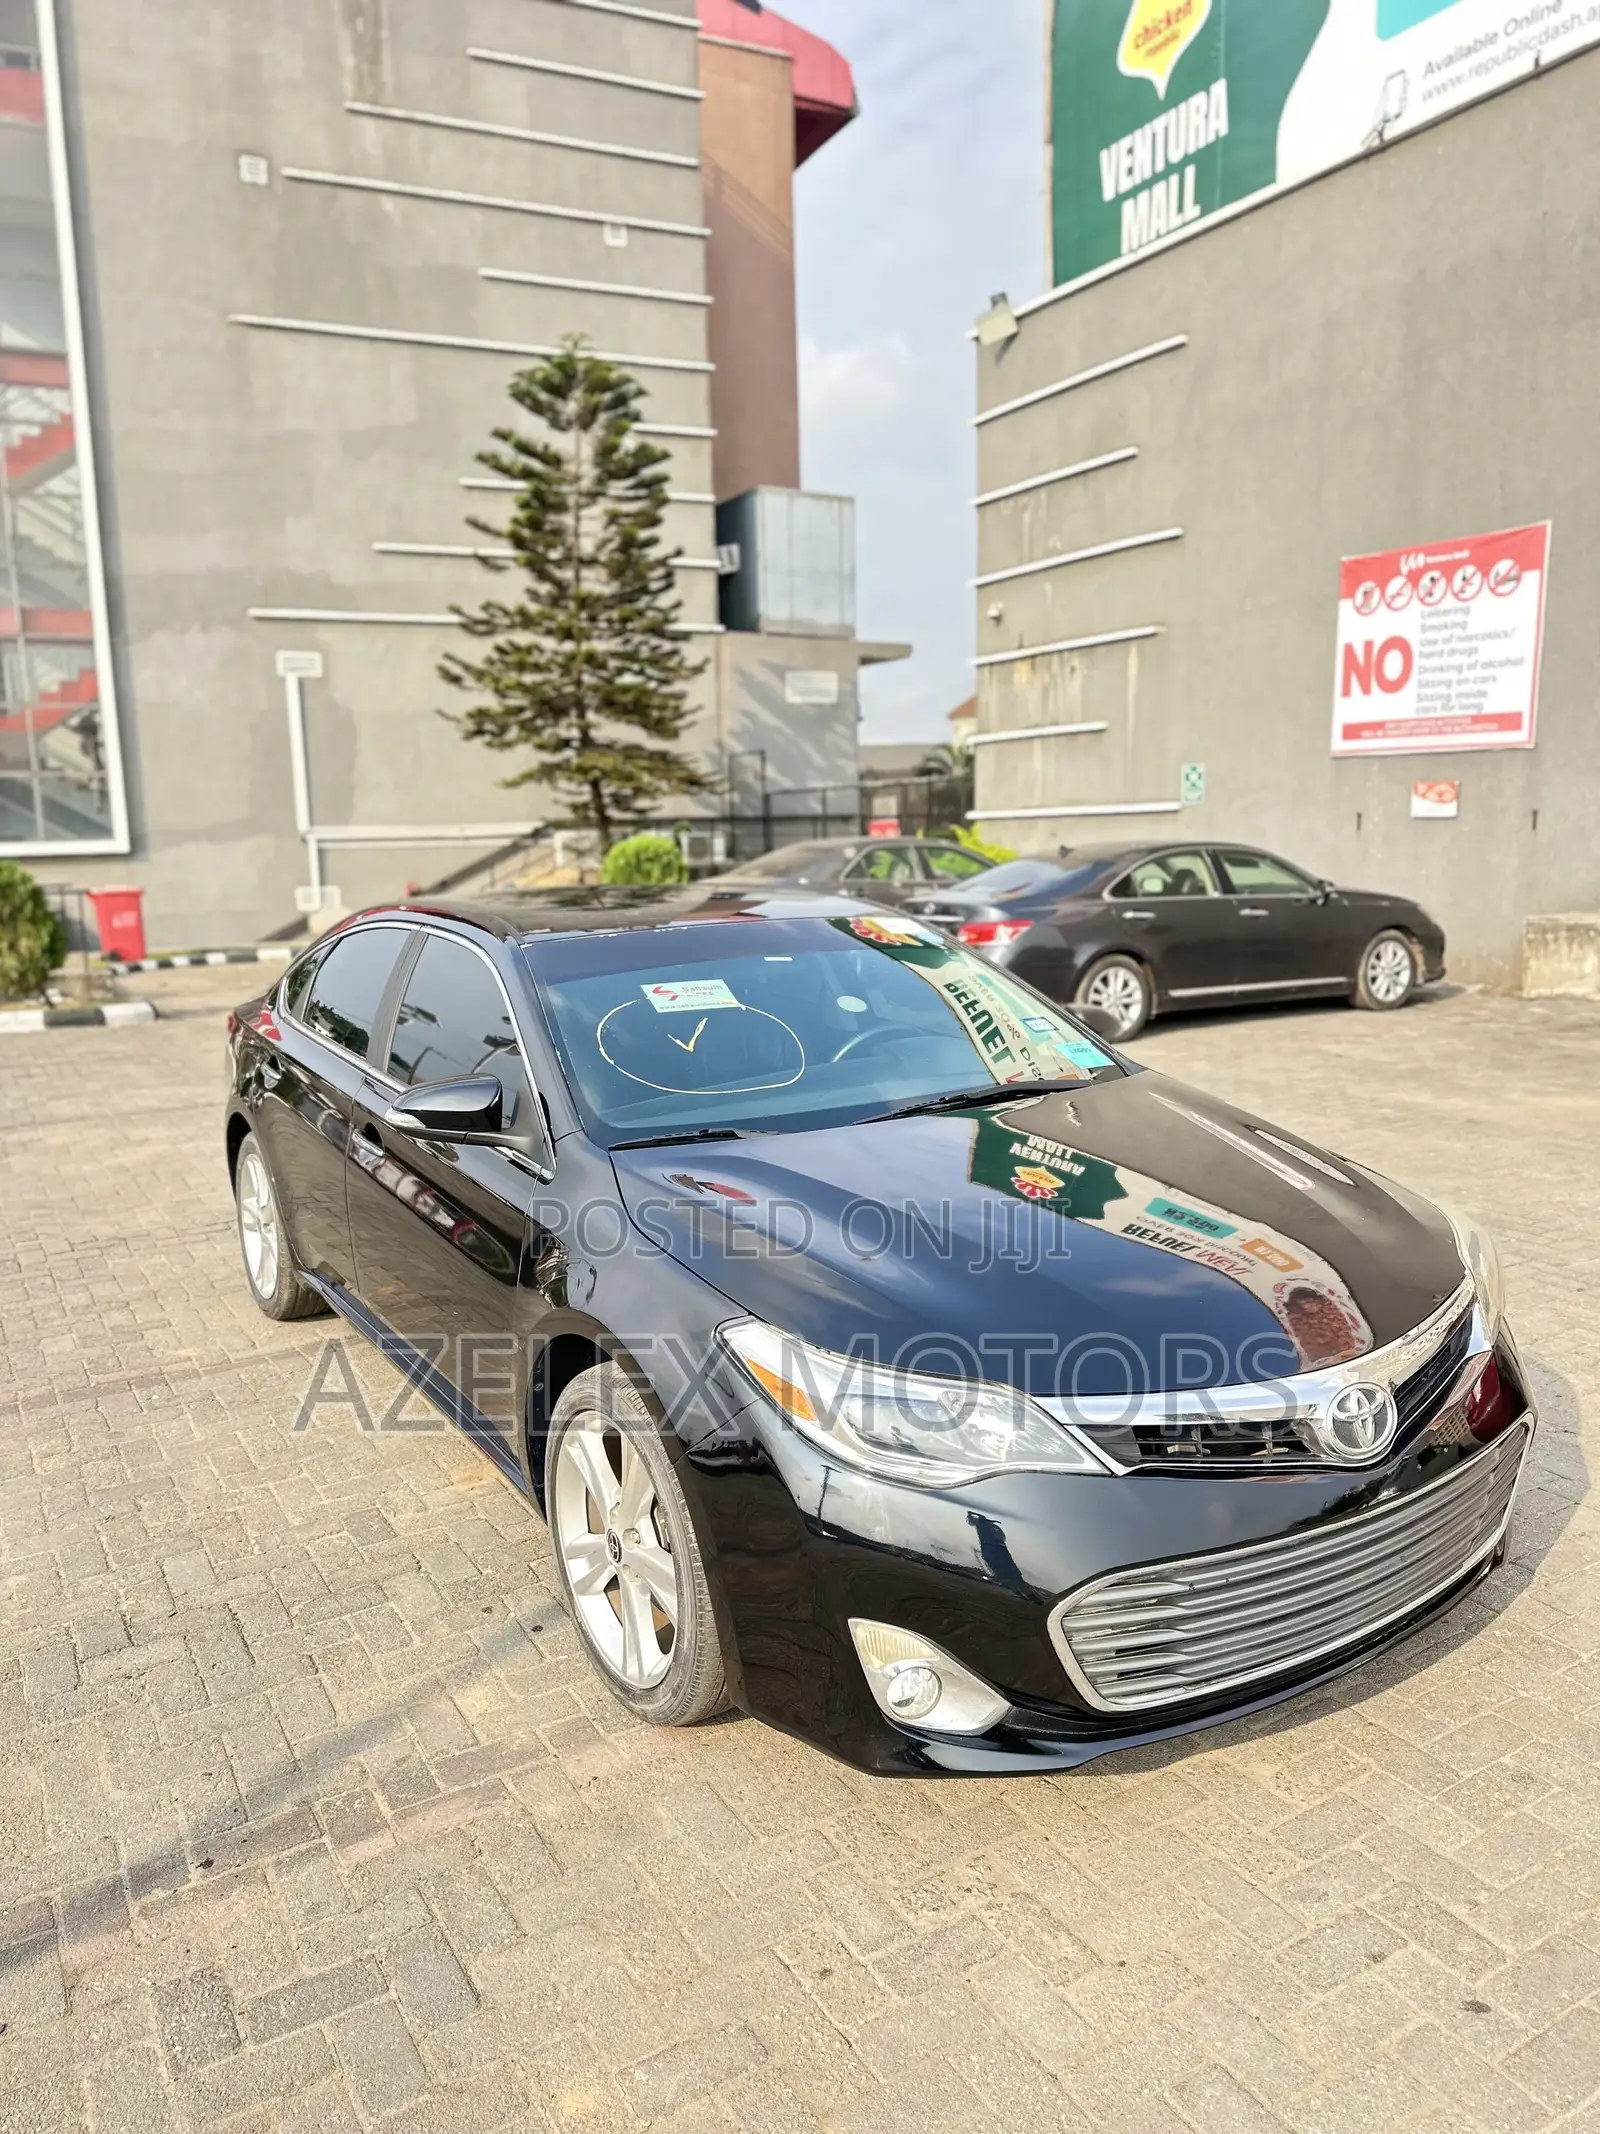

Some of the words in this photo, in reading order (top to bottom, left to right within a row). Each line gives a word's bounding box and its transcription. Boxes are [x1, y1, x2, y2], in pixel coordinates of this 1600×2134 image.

[1133, 0, 1193, 51] chicken
[1423, 31, 1499, 79] Available
[1503, 0, 1563, 37] Online
[1099, 78, 1230, 203] VENTURA
[1121, 164, 1201, 256] MALL
[1420, 620, 1468, 634] Smoking
[1441, 633, 1454, 645] of
[1341, 636, 1413, 698] NO
[1418, 663, 1463, 676] Drinking
[1466, 658, 1479, 671] of
[1480, 655, 1525, 670] alcohol
[1447, 646, 1478, 659] drugs
[1455, 677, 1470, 686] on
[1472, 674, 1497, 685] cars
